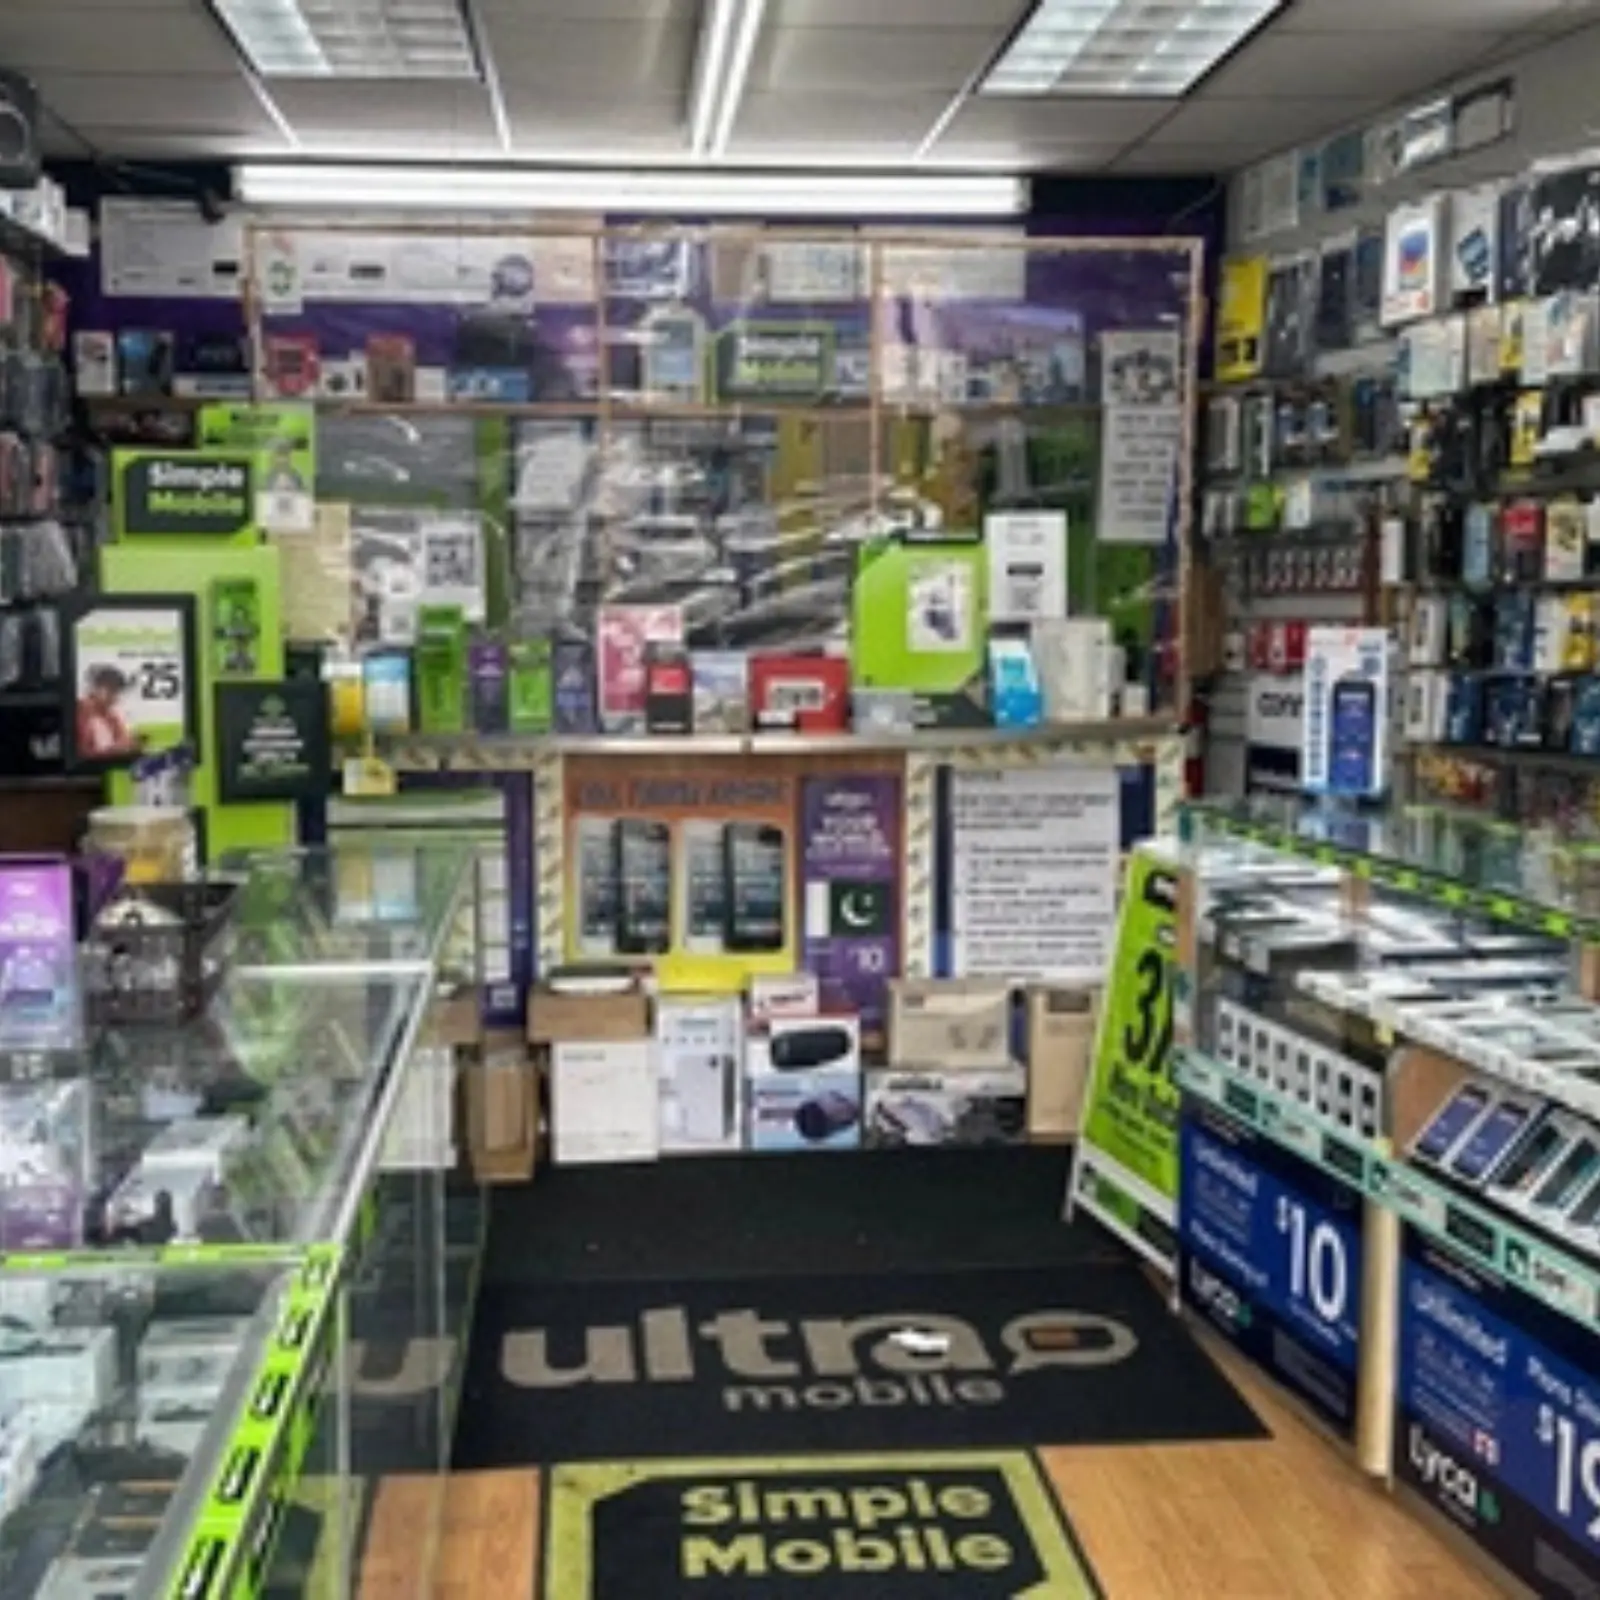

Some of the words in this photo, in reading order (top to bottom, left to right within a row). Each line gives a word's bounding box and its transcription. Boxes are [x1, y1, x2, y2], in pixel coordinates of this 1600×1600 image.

[147, 461, 245, 490] Simple
[1276, 1194, 1347, 1322] $10
[502, 1308, 994, 1388] ultra
[724, 1371, 1005, 1413] mobile
[681, 1479, 992, 1527] Simple
[681, 1526, 1011, 1579] Mobile
